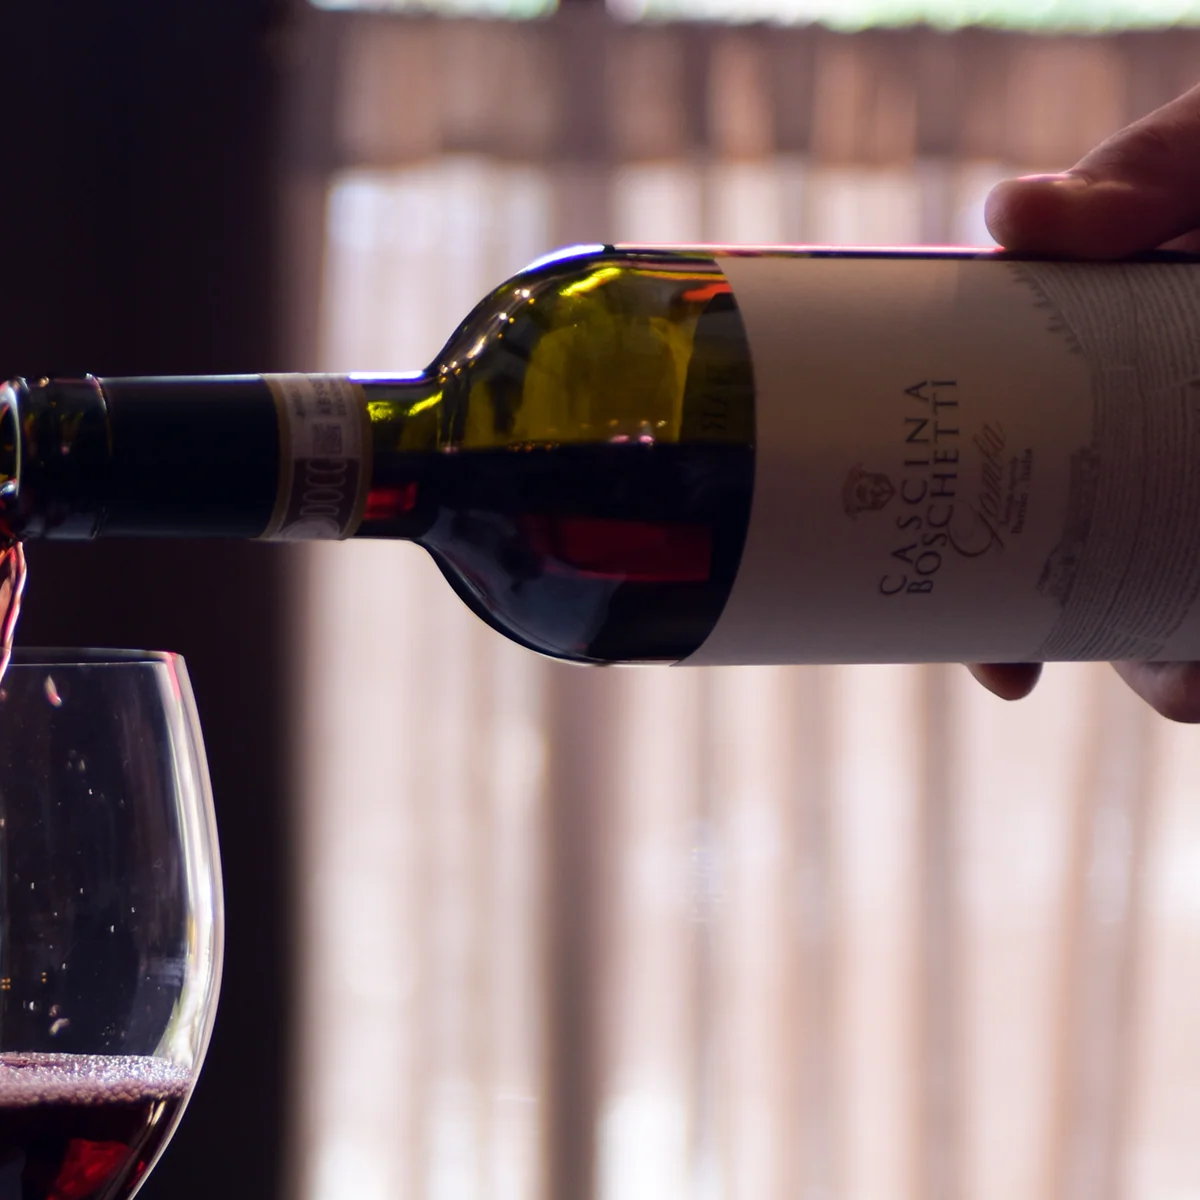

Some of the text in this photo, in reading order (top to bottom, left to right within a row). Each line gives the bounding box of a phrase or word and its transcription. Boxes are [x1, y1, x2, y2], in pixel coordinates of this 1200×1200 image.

[299, 459, 348, 516] DOCG
[877, 379, 931, 597] CASCINA
[906, 379, 960, 595] BOSCHETTI
